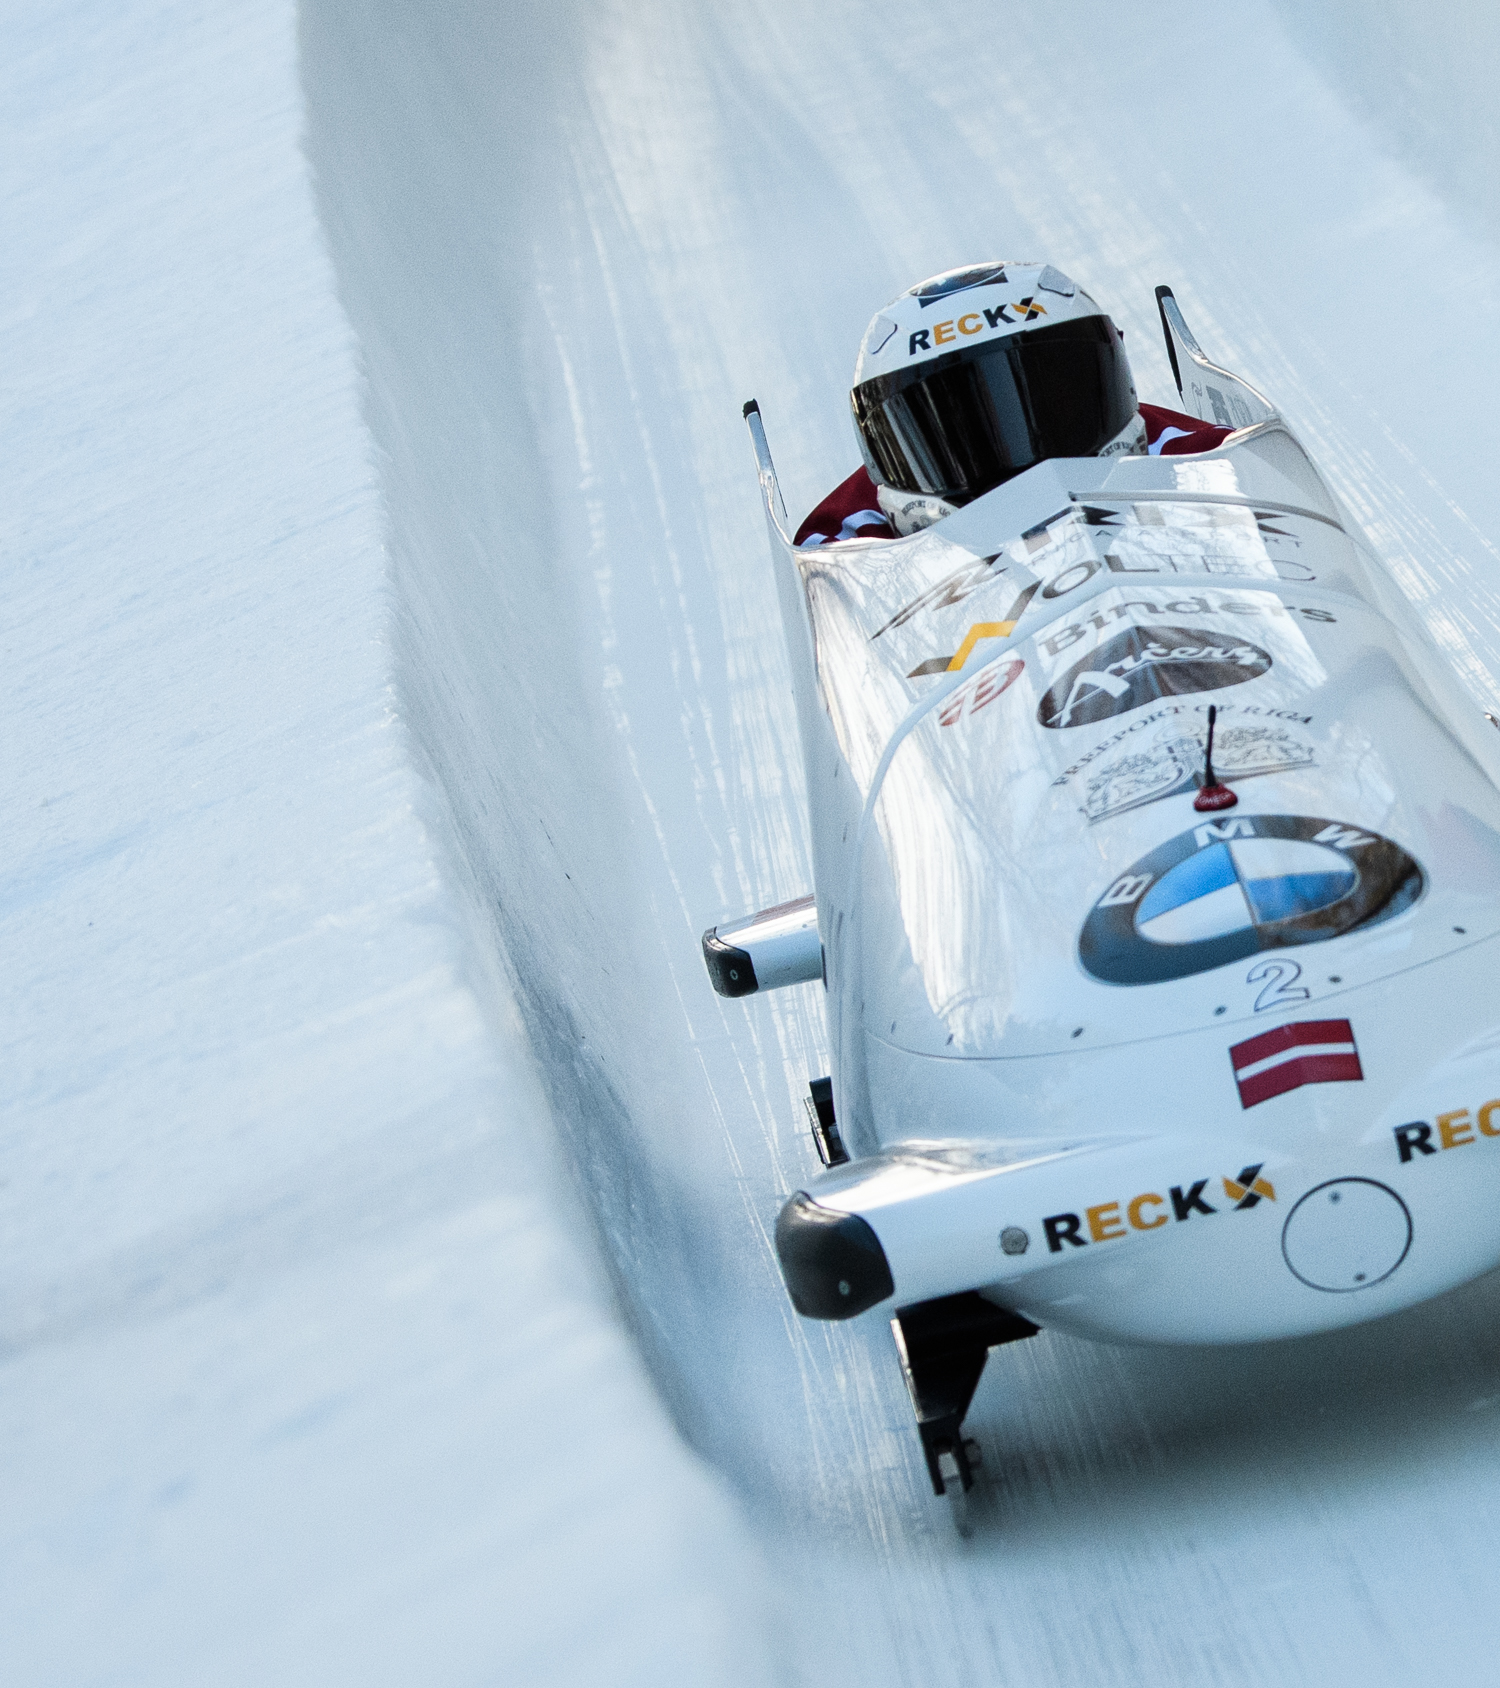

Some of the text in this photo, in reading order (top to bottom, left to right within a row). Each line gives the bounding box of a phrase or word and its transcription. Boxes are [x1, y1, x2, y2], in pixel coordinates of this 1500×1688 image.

[1038, 597, 1338, 657] Binders
[1050, 704, 1314, 787] FREEPORT OF RIGA
[1246, 957, 1312, 1013] 2
